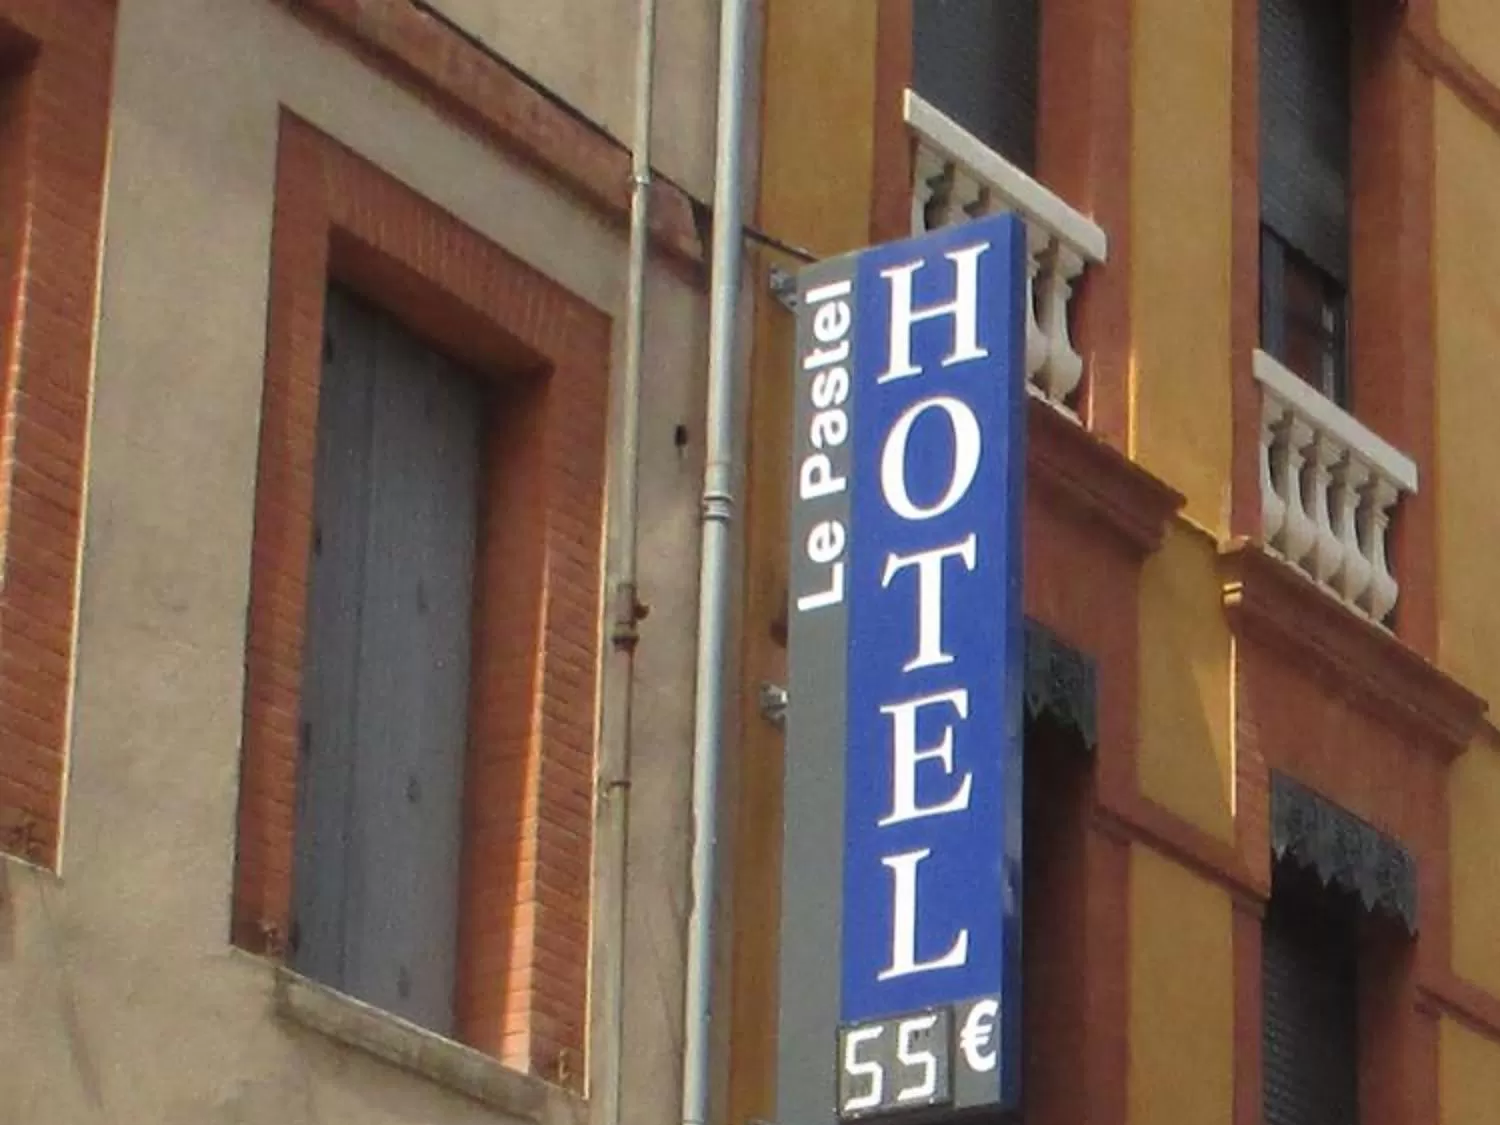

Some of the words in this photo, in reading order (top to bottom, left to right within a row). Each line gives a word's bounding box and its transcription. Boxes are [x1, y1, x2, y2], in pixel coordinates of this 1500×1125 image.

[801, 279, 851, 500] Pastel
[797, 519, 846, 611] Le
[877, 242, 990, 981] HOTEL
